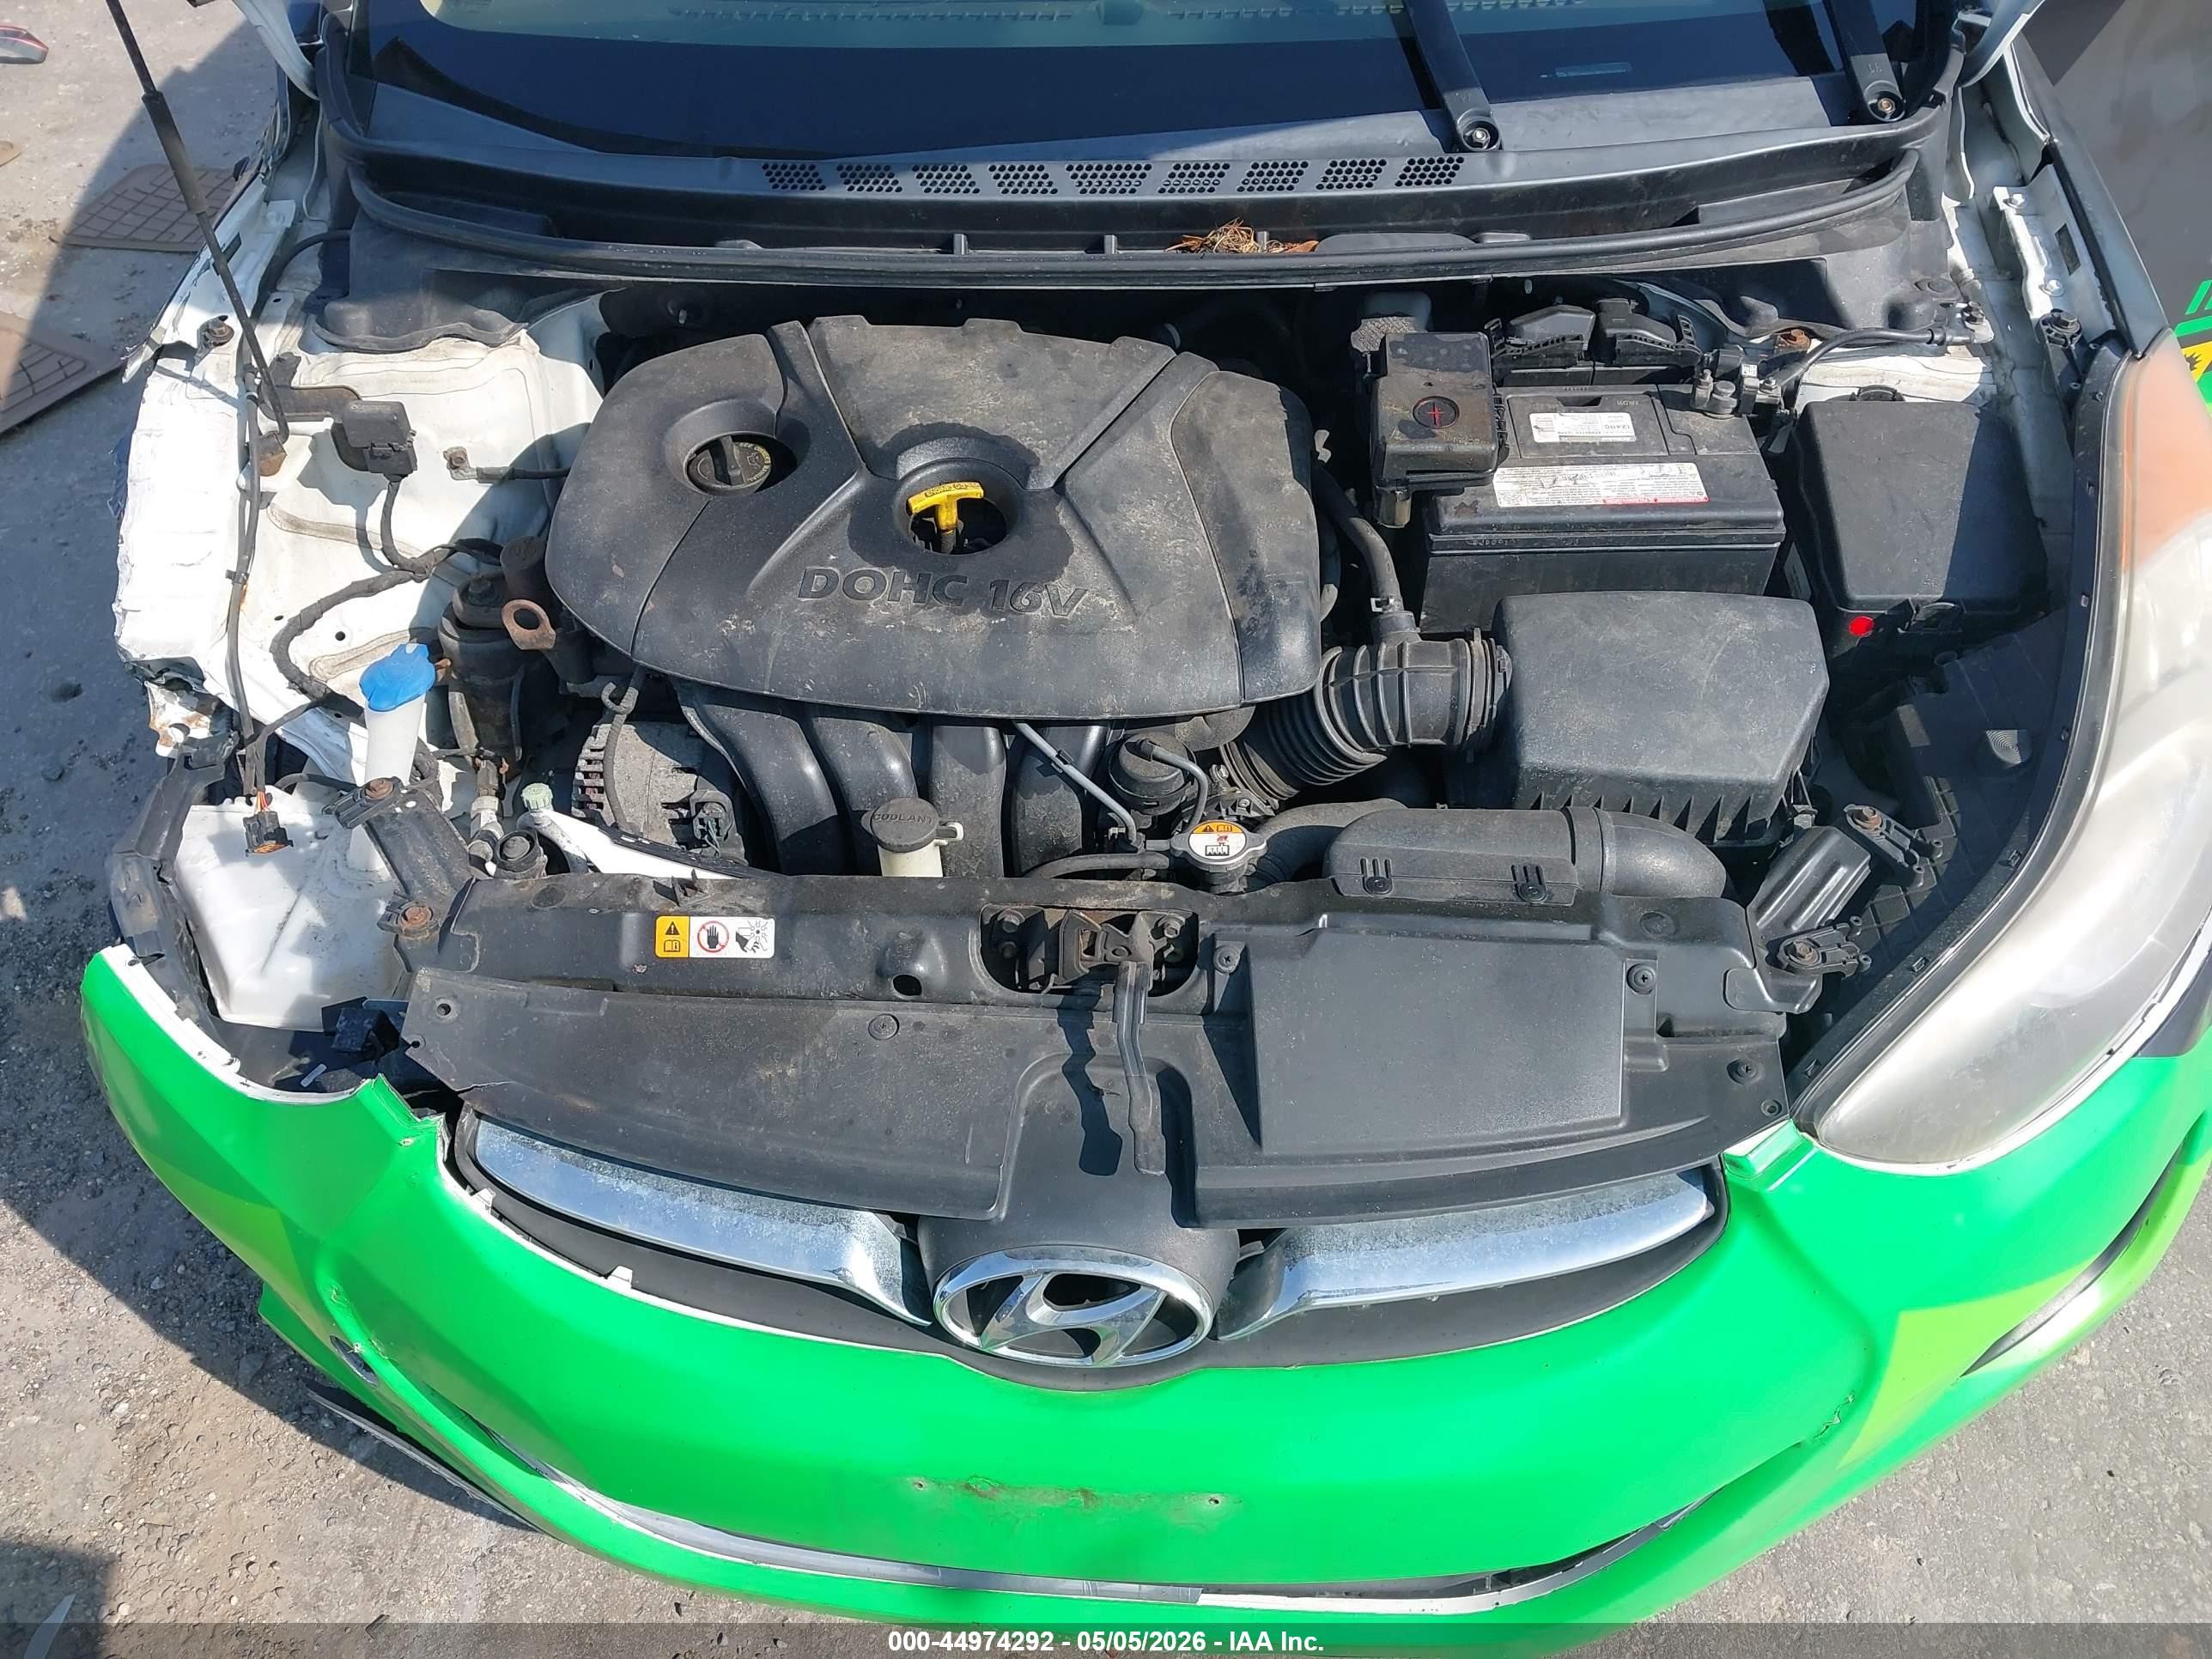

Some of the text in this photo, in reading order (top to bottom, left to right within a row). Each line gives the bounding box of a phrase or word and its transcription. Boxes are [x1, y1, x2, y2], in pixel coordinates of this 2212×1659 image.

[925, 485, 952, 497] ENGINE
[798, 568, 1088, 617] DOHC 16V
[872, 812, 933, 825] COOLANT
